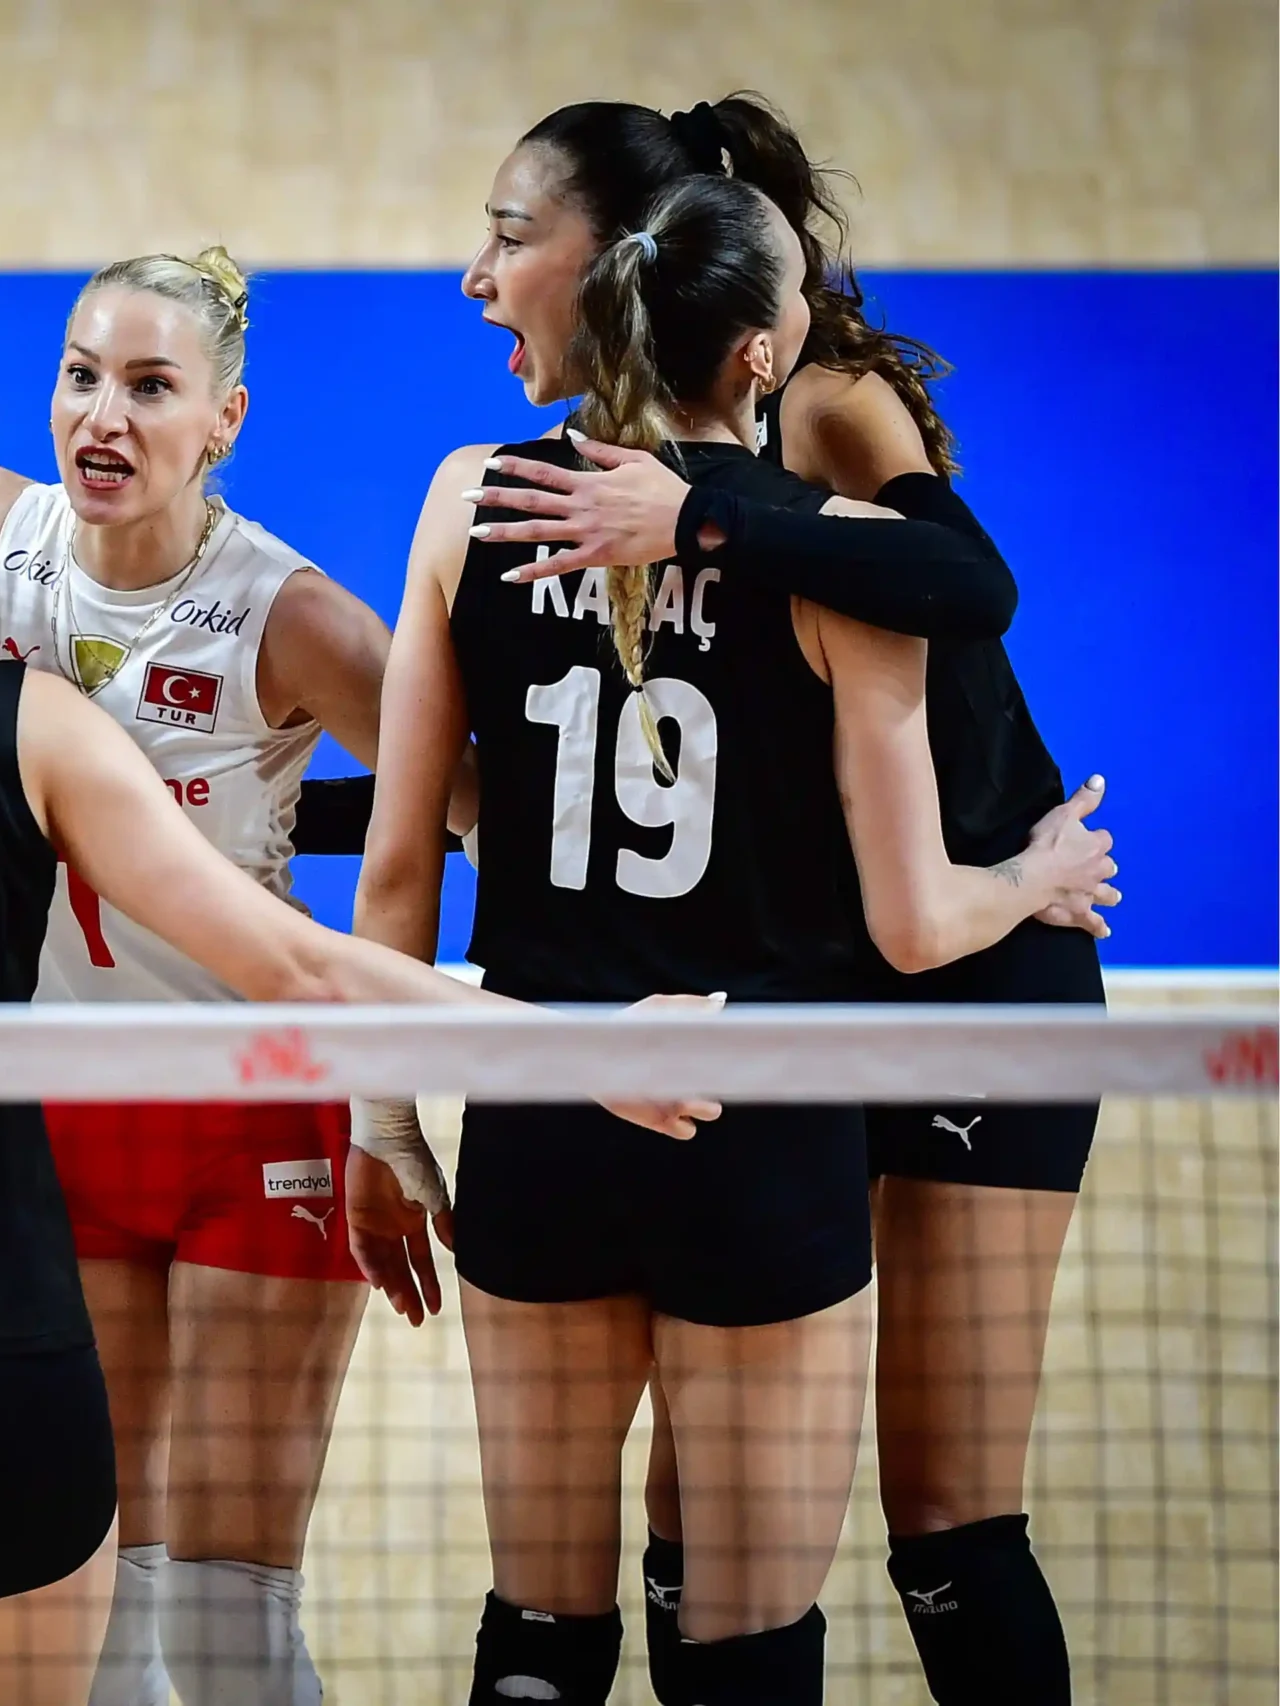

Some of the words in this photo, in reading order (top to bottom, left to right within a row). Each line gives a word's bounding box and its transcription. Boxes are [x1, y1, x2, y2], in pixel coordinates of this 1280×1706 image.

[4, 549, 66, 590] Okid
[171, 599, 251, 636] Orkid
[531, 545, 721, 652] KAAÇ
[157, 707, 196, 725] TUR
[525, 665, 718, 898] 19
[268, 1175, 331, 1191] trendyol
